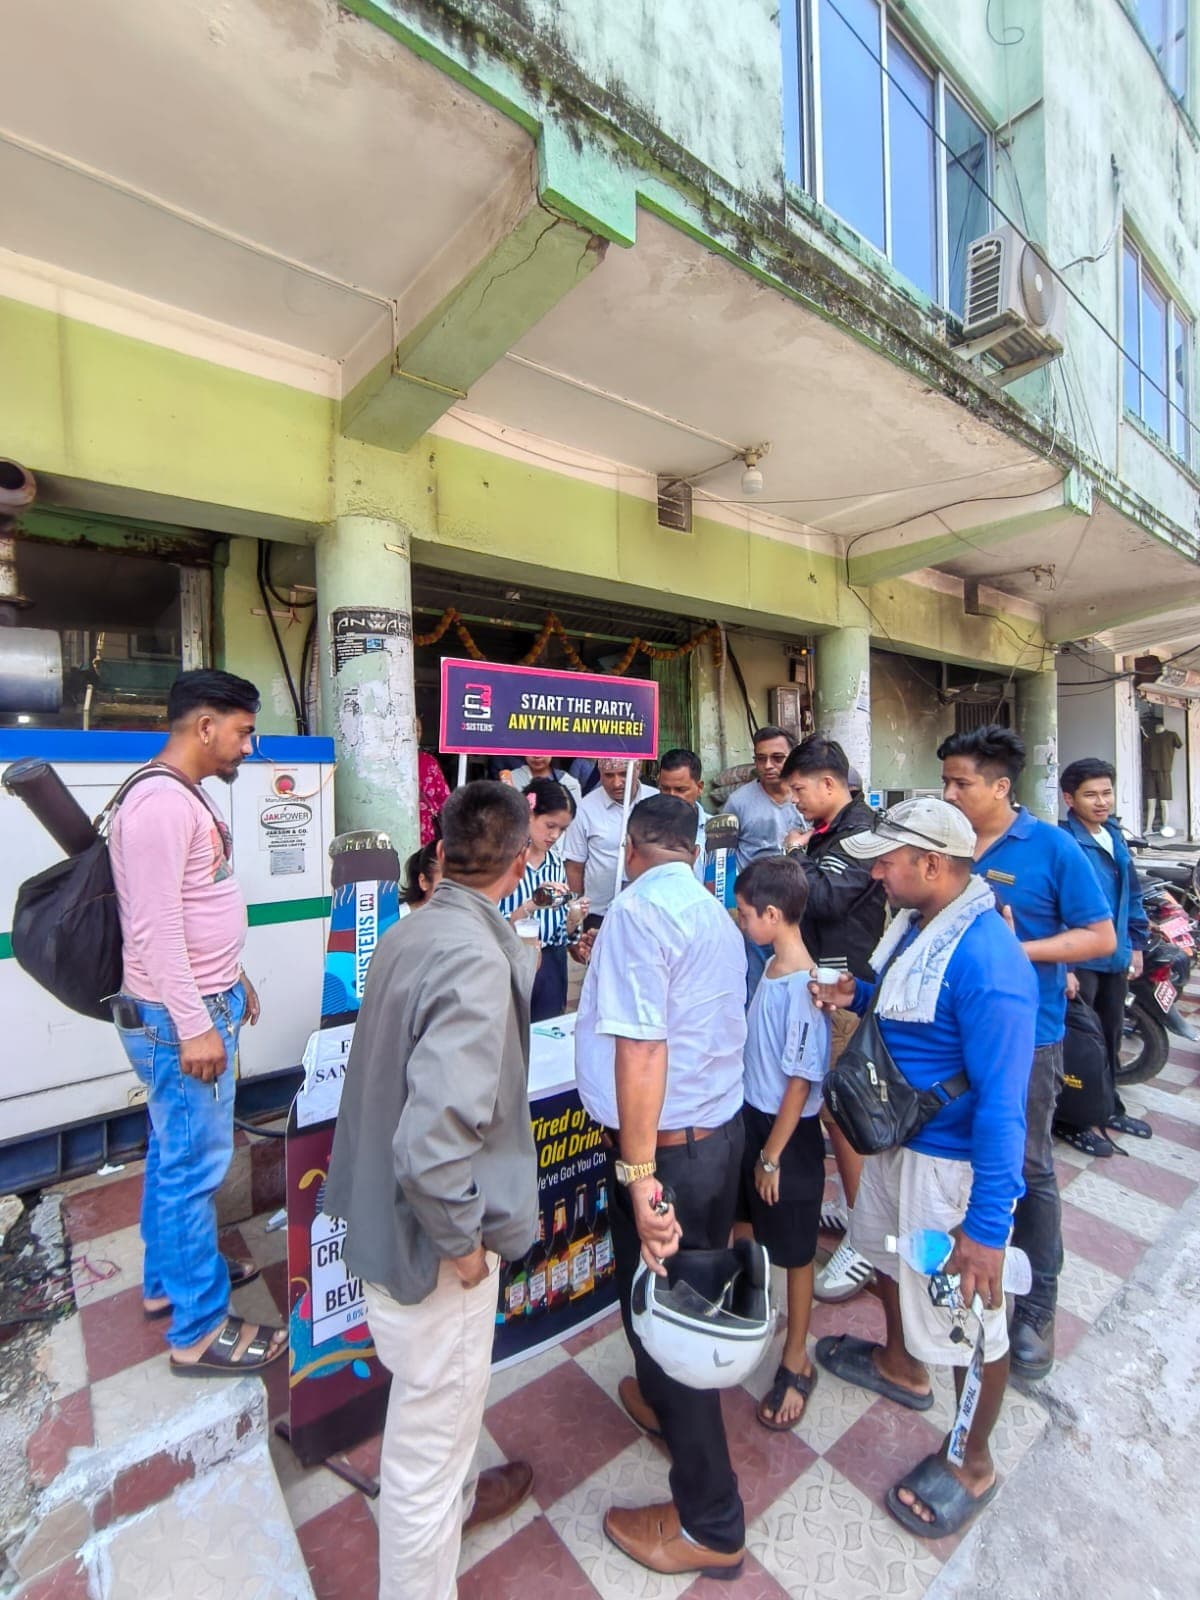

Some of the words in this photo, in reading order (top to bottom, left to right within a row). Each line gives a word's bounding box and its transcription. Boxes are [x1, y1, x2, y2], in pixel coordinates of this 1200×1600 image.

[521, 693, 562, 712] START
[567, 697, 590, 715] THE
[594, 699, 634, 721] PARTY,
[508, 713, 569, 732] ANYTIME
[572, 718, 643, 737] ANYWHERE!
[264, 812, 309, 822] JAKPOWER
[358, 915, 375, 994] ISTERS
[530, 1107, 570, 1142] Tired
[540, 1136, 567, 1169] Old
[560, 1164, 576, 1182] Got
[577, 1157, 592, 1174] You
